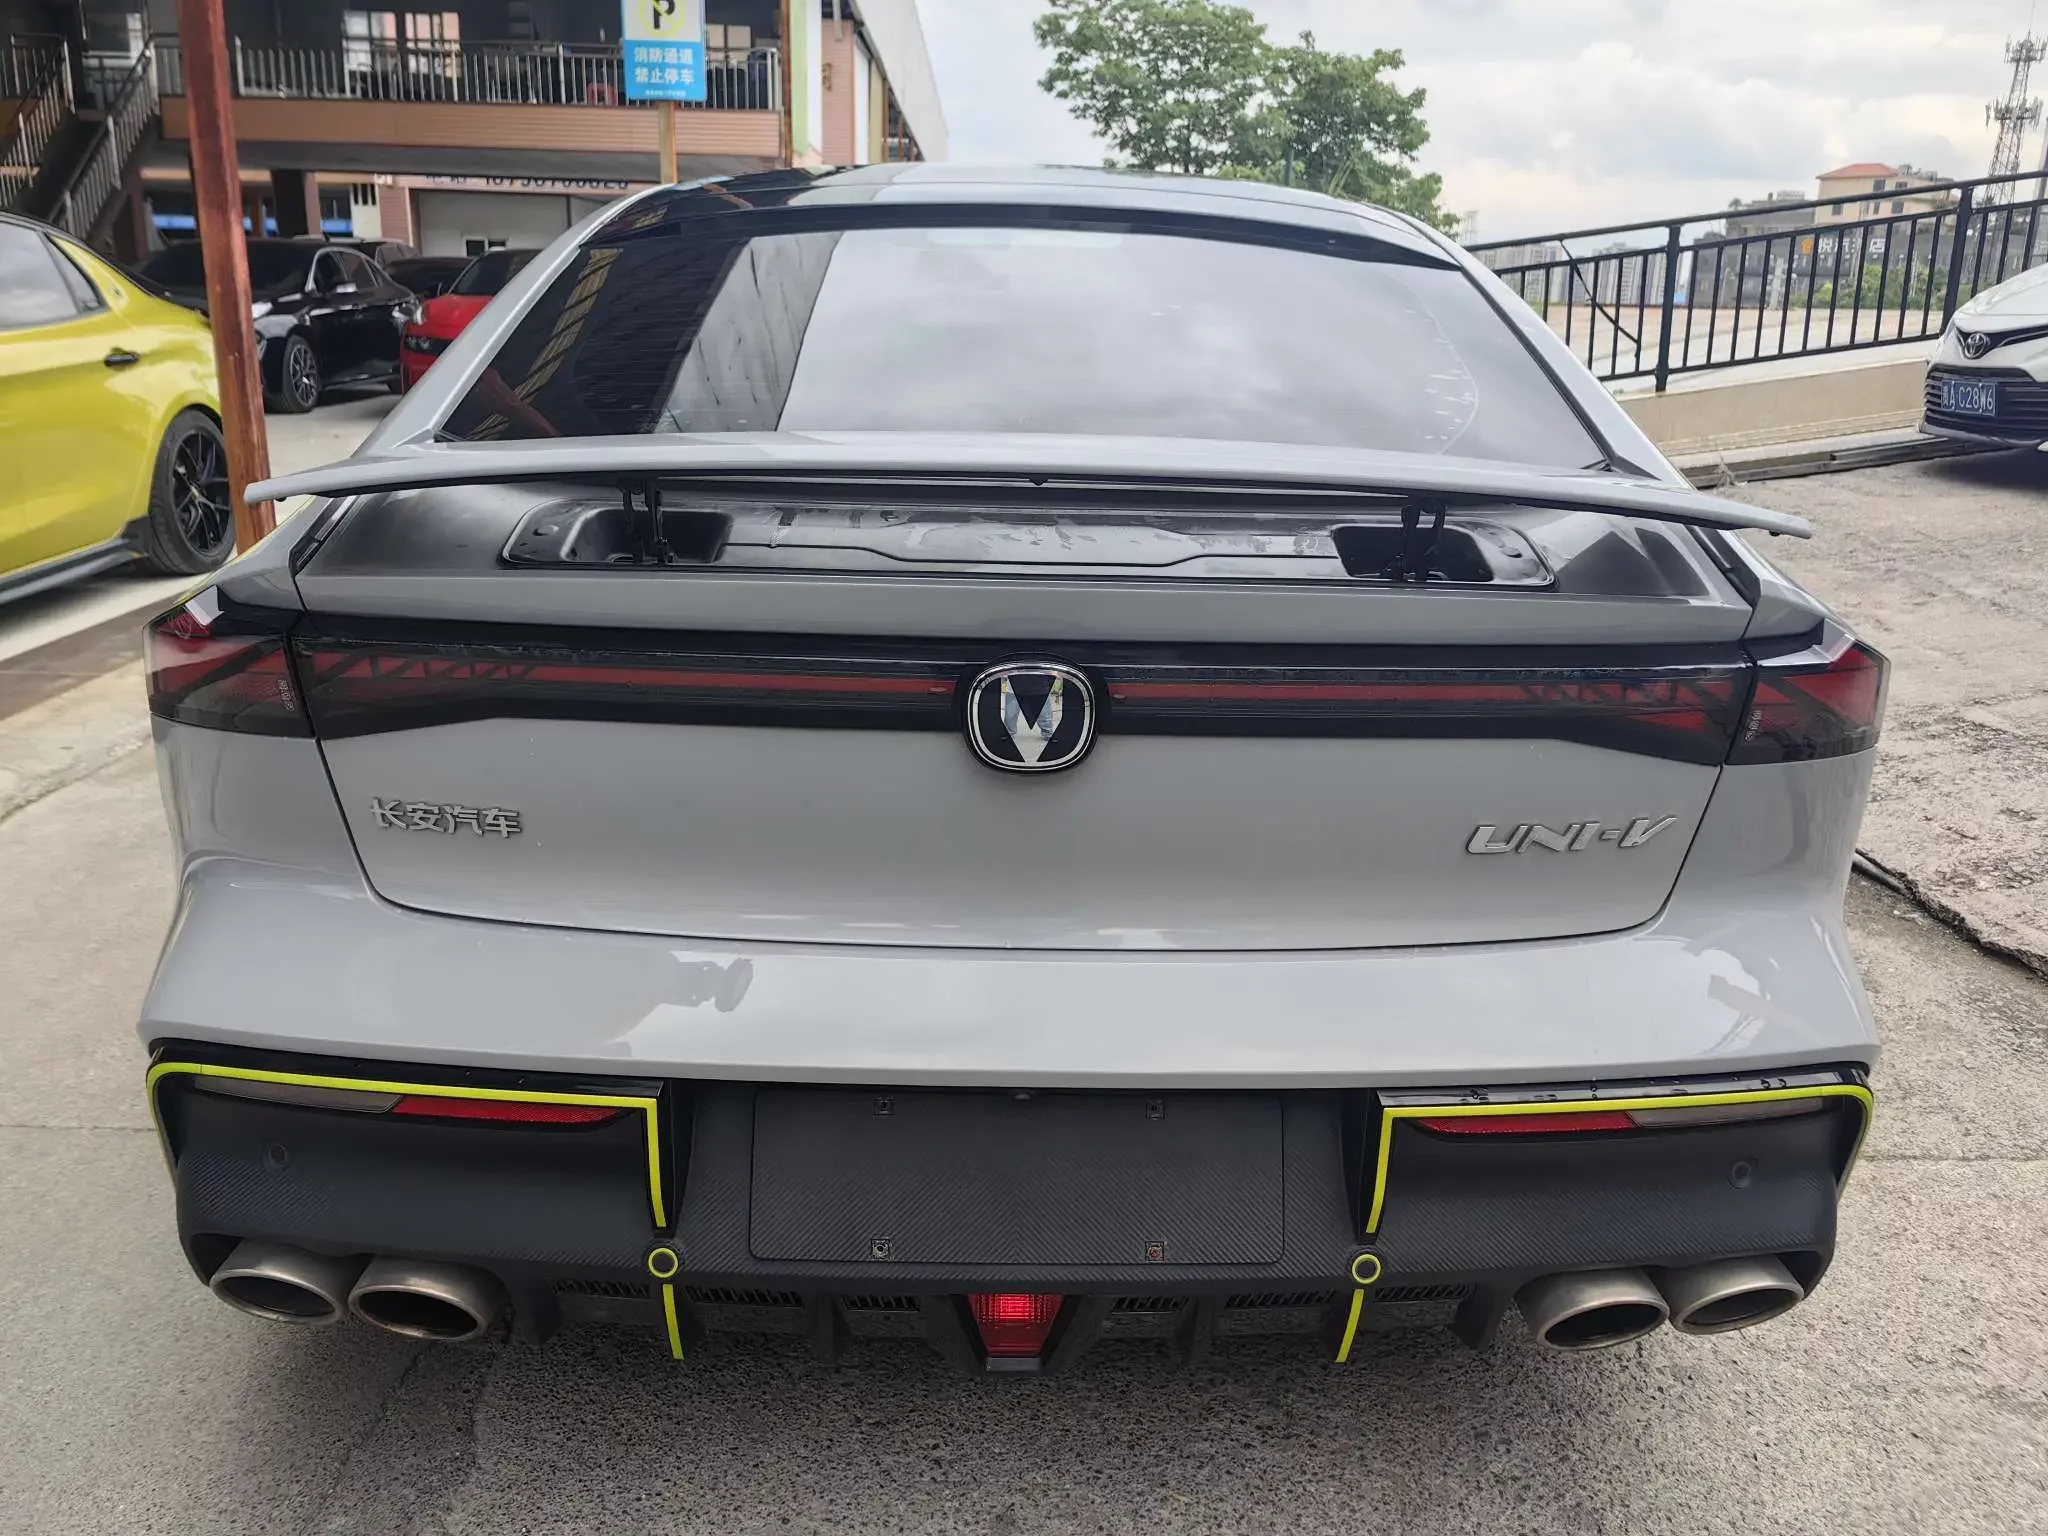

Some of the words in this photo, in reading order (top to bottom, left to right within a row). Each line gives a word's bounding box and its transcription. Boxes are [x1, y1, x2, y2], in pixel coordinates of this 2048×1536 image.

[634, 46, 693, 65] 消防通道
[635, 66, 695, 85] 禁止停车
[370, 797, 522, 838] 长安汽车
[1466, 815, 1678, 854] UNI-V
